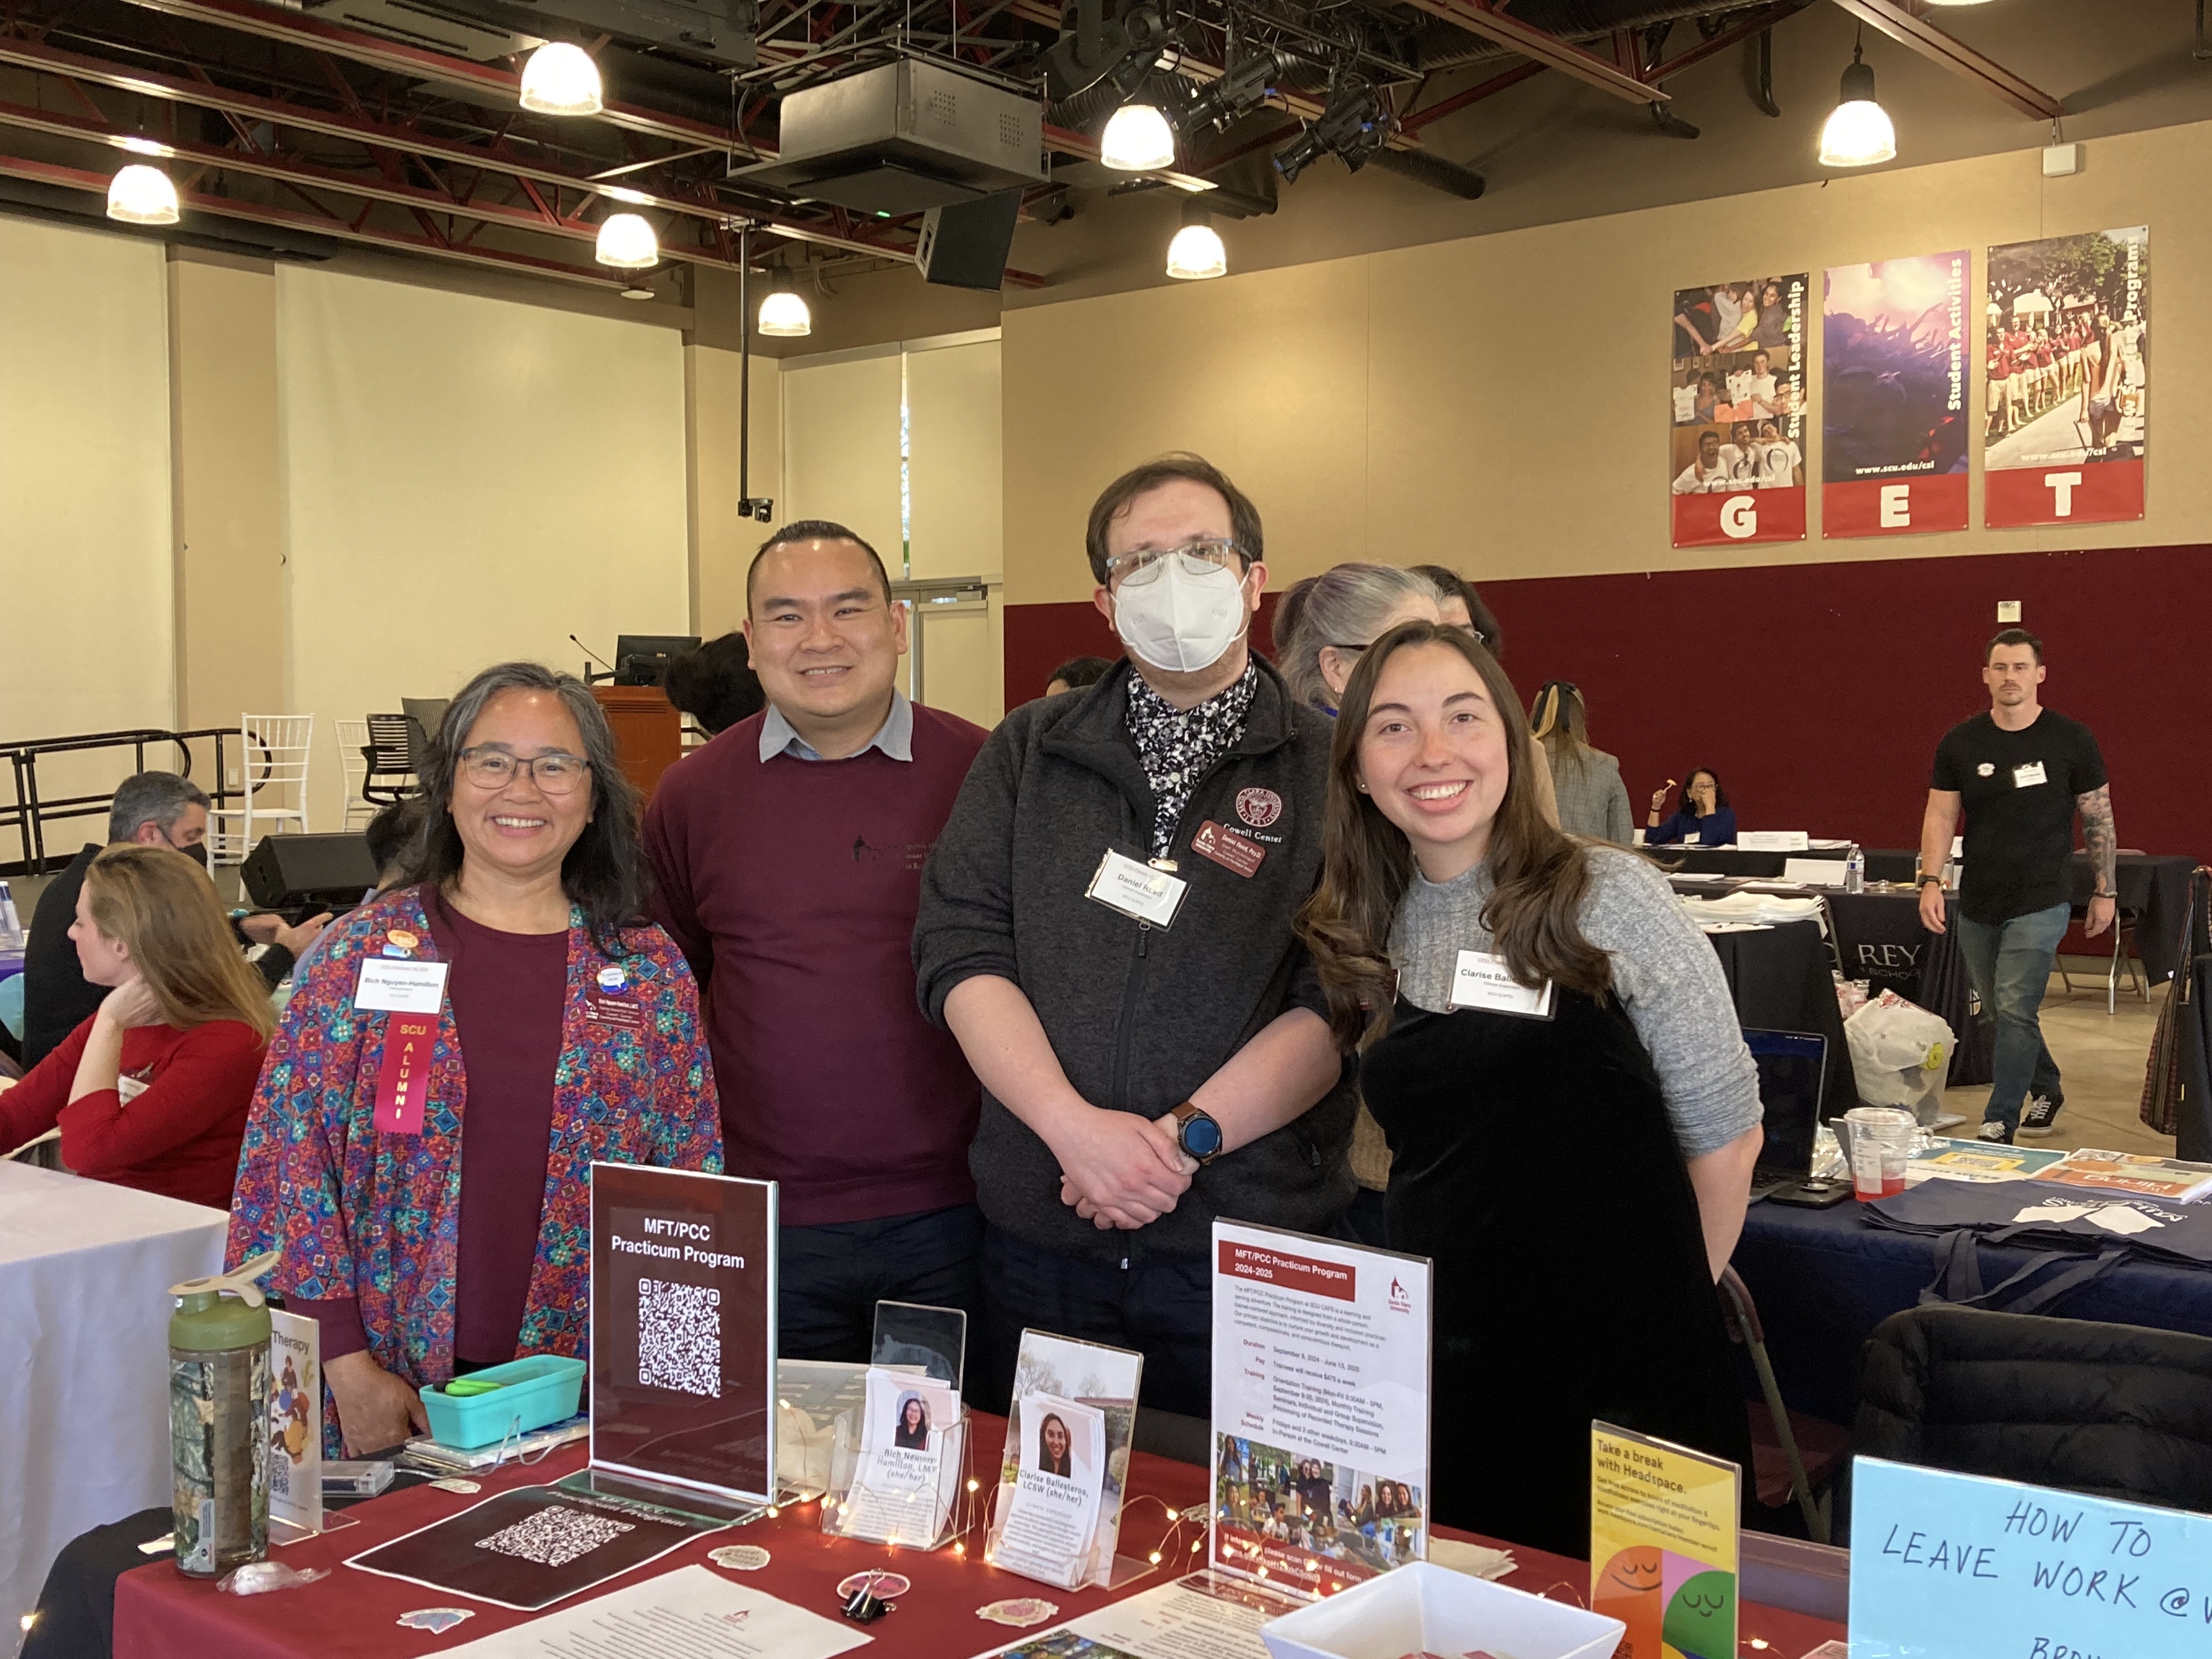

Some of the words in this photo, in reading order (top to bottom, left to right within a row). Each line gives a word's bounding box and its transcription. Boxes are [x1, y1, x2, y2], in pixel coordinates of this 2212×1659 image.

[2124, 236, 2142, 321] Programs
[1948, 258, 1962, 340] Activities
[1788, 281, 1804, 371] Leadership
[1948, 343, 1961, 410] Student
[1788, 373, 1801, 438] Student
[2021, 447, 2107, 461] www.scu.edu/csl
[1703, 474, 1775, 487] www.scu.edu/csl
[1855, 460, 1934, 475] www.scu.edu/csl
[1881, 484, 1910, 528] E
[2045, 472, 2082, 516] T
[1720, 495, 1757, 538] G
[1223, 823, 1252, 837] Cowell
[1254, 831, 1282, 843] Center
[1116, 873, 1142, 888] Daniel
[1858, 944, 1923, 967] REY
[1460, 968, 1492, 979] Clarise
[399, 1024, 427, 1035] SCU
[394, 1042, 414, 1119] ALUMNI
[644, 1217, 711, 1242] MFT/PCC
[612, 1235, 681, 1260] Practicum
[684, 1245, 745, 1269] Program
[1235, 1248, 1271, 1265] MFT/PCC
[1272, 1256, 1310, 1273] Practicum
[1312, 1265, 1347, 1282] Program
[1235, 1262, 1273, 1279] 2024-2025
[272, 1330, 311, 1354] Therapy
[1243, 1339, 1265, 1350] Duration
[1255, 1356, 1265, 1365] Pay
[1273, 1346, 1300, 1358] September
[1307, 1354, 1319, 1363] 2024
[1324, 1358, 1336, 1367] June
[1347, 1364, 1359, 1373] 2025
[1244, 1368, 1264, 1380] Training
[1273, 1361, 1294, 1372] Trainees
[1304, 1368, 1322, 1379] receive
[1342, 1378, 1355, 1387] week
[1273, 1375, 1300, 1388] Orientation
[1301, 1383, 1321, 1394] Training
[1273, 1385, 1299, 1397] September
[1331, 1400, 1352, 1412] Monthly
[1353, 1406, 1374, 1418] Training
[1241, 1419, 1263, 1431] Schedule
[1246, 1412, 1263, 1422] Weekly
[1273, 1404, 1300, 1417] Processing
[1307, 1413, 1332, 1425] Recorded
[1334, 1420, 1353, 1431] Therapy
[1355, 1425, 1379, 1437] Sessions
[1273, 1419, 1290, 1430] Fridays
[1291, 1424, 1301, 1432] and
[1334, 1410, 1351, 1420] Group
[1273, 1428, 1296, 1440] In-Person
[1303, 1436, 1311, 1444] the
[1313, 1438, 1330, 1449] Cowell
[1331, 1443, 1348, 1454] Center
[1597, 1438, 1621, 1456] Take
[1624, 1449, 1629, 1459] a
[1633, 1449, 1663, 1470] break
[877, 1455, 916, 1474] Hamilton,
[884, 1448, 905, 1461] Bich
[887, 1470, 926, 1484] (she/her)
[1019, 1469, 1045, 1483] Clarise
[1046, 1475, 1089, 1498] Ballesteros,
[1596, 1454, 1620, 1474] with
[1624, 1464, 1686, 1493] Headspace.
[1023, 1481, 1045, 1495] LCSW
[1046, 1487, 1082, 1507] (she/her)
[2004, 1500, 2084, 1543] HOW
[2110, 1520, 2152, 1557] TO
[1264, 1547, 1285, 1558] please
[1286, 1554, 1302, 1563] scan
[1324, 1565, 1333, 1573] fill
[1334, 1568, 1345, 1578] out
[1346, 1571, 1362, 1583] form
[1882, 1523, 1999, 1578] LEAVE
[2033, 1560, 2140, 1609] WORK
[2160, 1587, 2190, 1617] @
